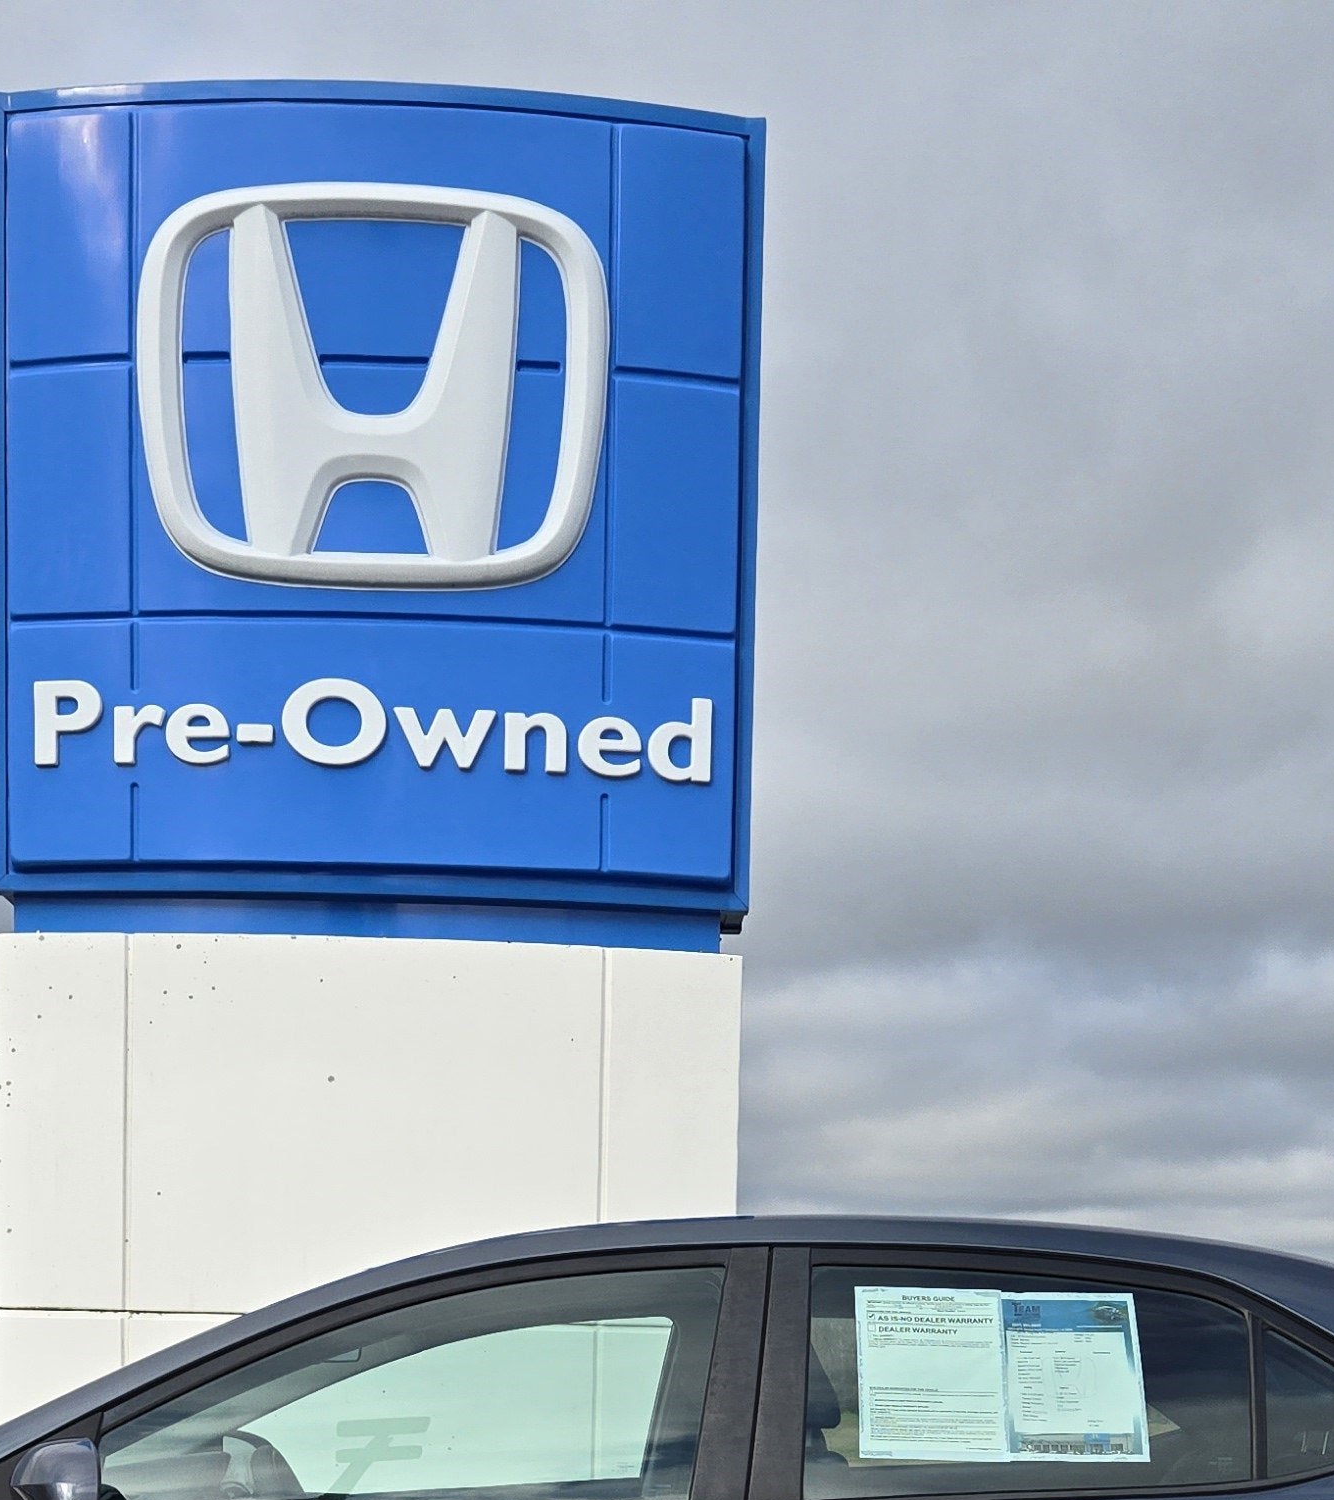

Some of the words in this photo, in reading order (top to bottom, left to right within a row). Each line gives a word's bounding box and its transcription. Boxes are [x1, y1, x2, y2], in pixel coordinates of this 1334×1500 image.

[32, 677, 714, 784] Pre-Owned
[901, 1294, 931, 1302] BUYERS
[932, 1295, 955, 1303] GUIDE
[914, 1316, 947, 1324] DEALER
[947, 1317, 994, 1325] WARRANTY
[878, 1325, 911, 1333] DEALER
[912, 1326, 958, 1335] WARRANTY
